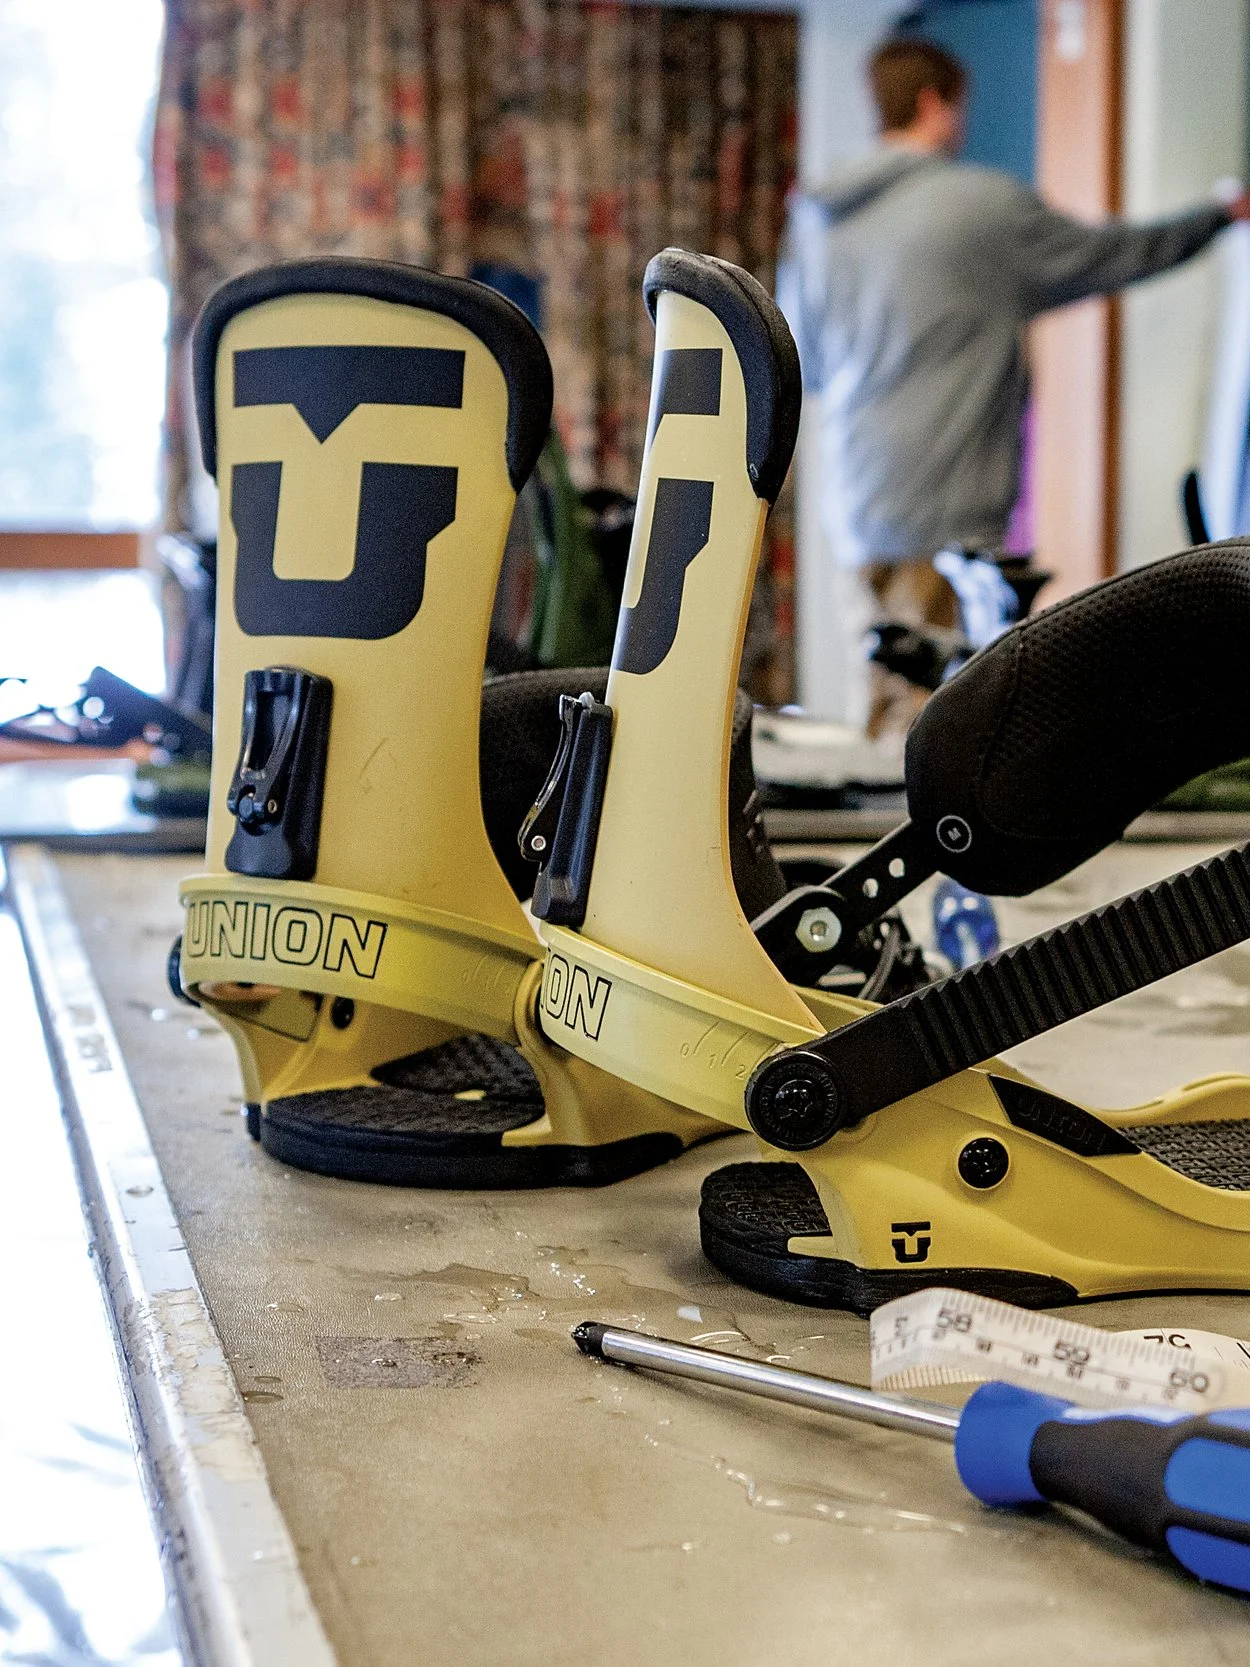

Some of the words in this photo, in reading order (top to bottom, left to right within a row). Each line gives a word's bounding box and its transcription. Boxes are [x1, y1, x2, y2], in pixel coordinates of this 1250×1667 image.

[186, 900, 388, 980] UNION
[735, 1064, 746, 1080] 2
[937, 1308, 973, 1332] 58
[1169, 1368, 1210, 1393] 60
